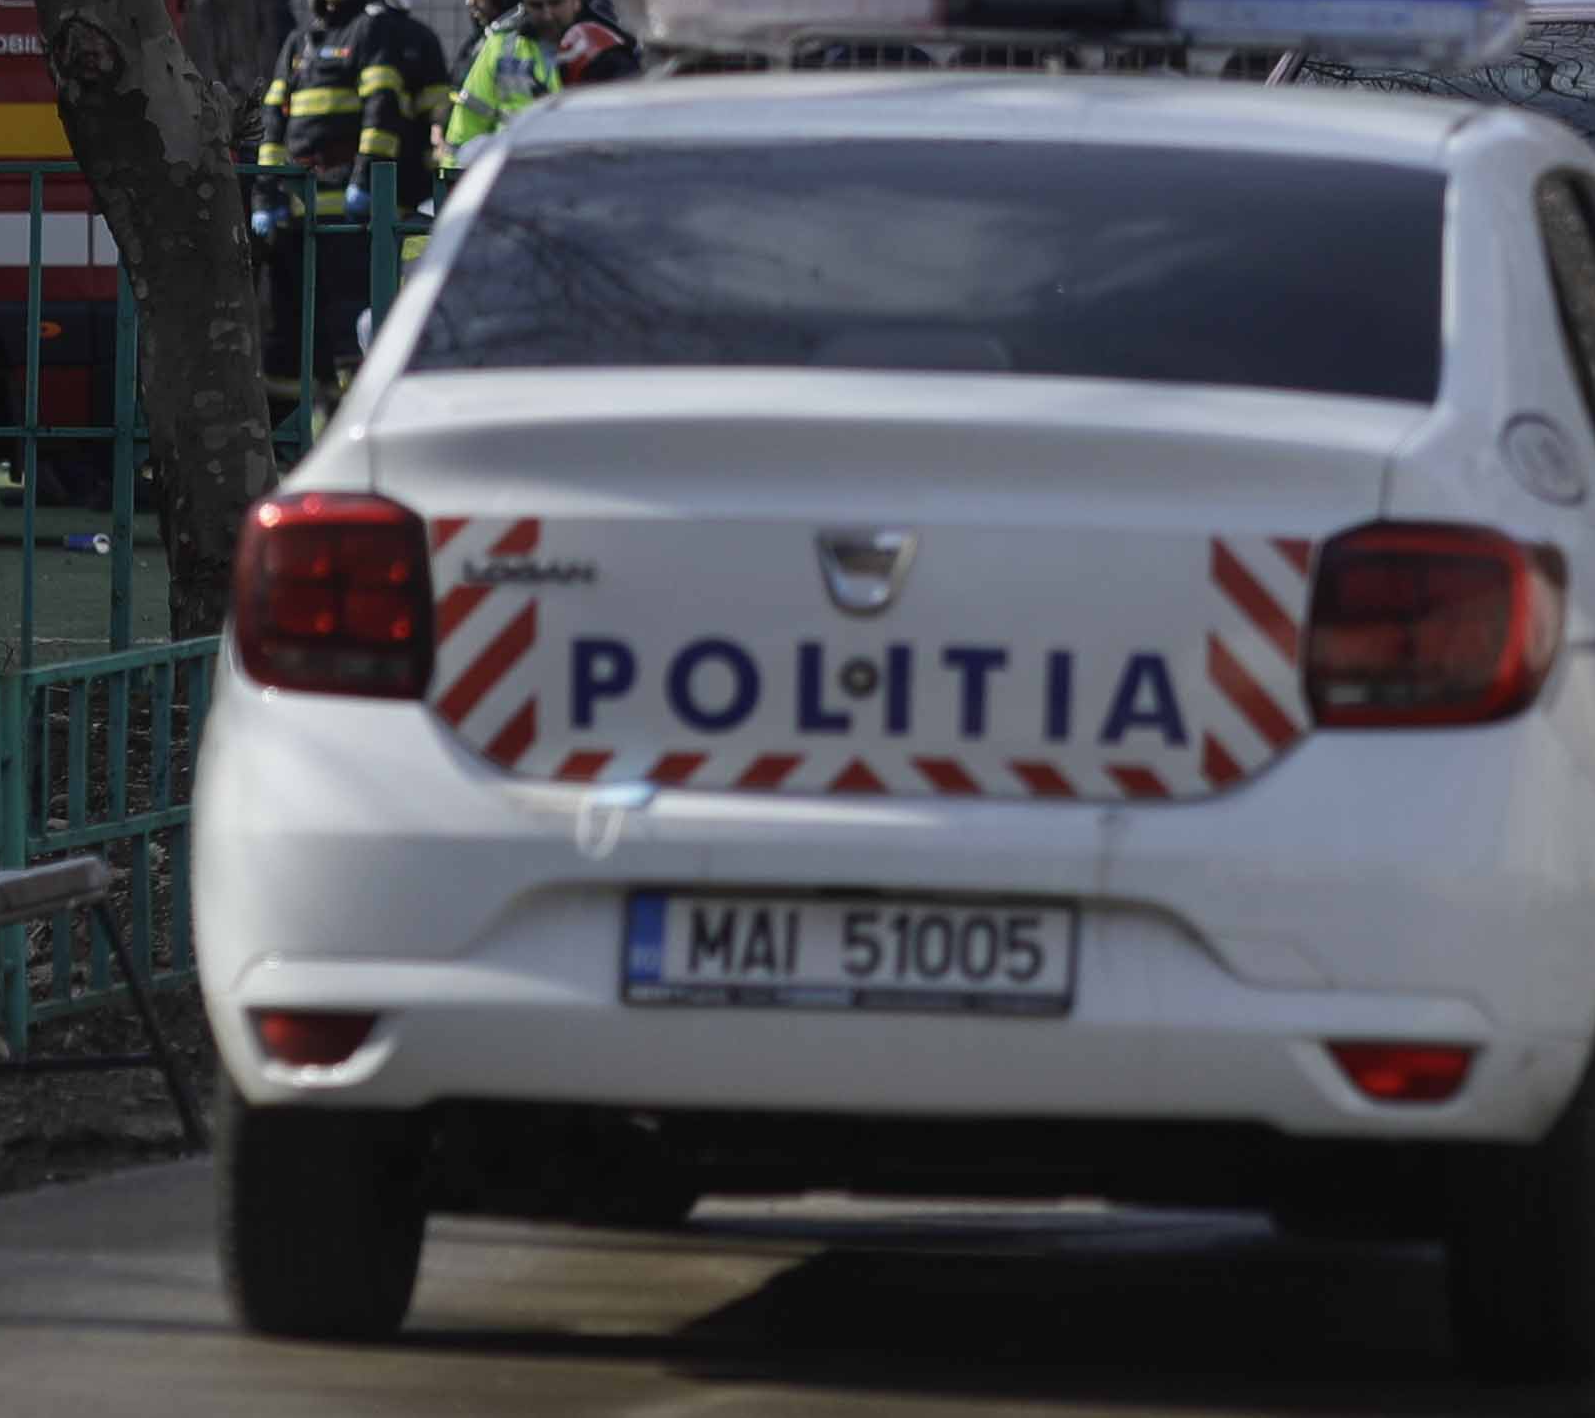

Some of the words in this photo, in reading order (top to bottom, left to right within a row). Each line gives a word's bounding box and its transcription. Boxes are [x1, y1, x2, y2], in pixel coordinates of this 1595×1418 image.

[462, 557, 597, 586] LOGAN
[569, 636, 1188, 748] POLITIA
[688, 908, 798, 974] MAI
[841, 910, 1043, 981] 51005
